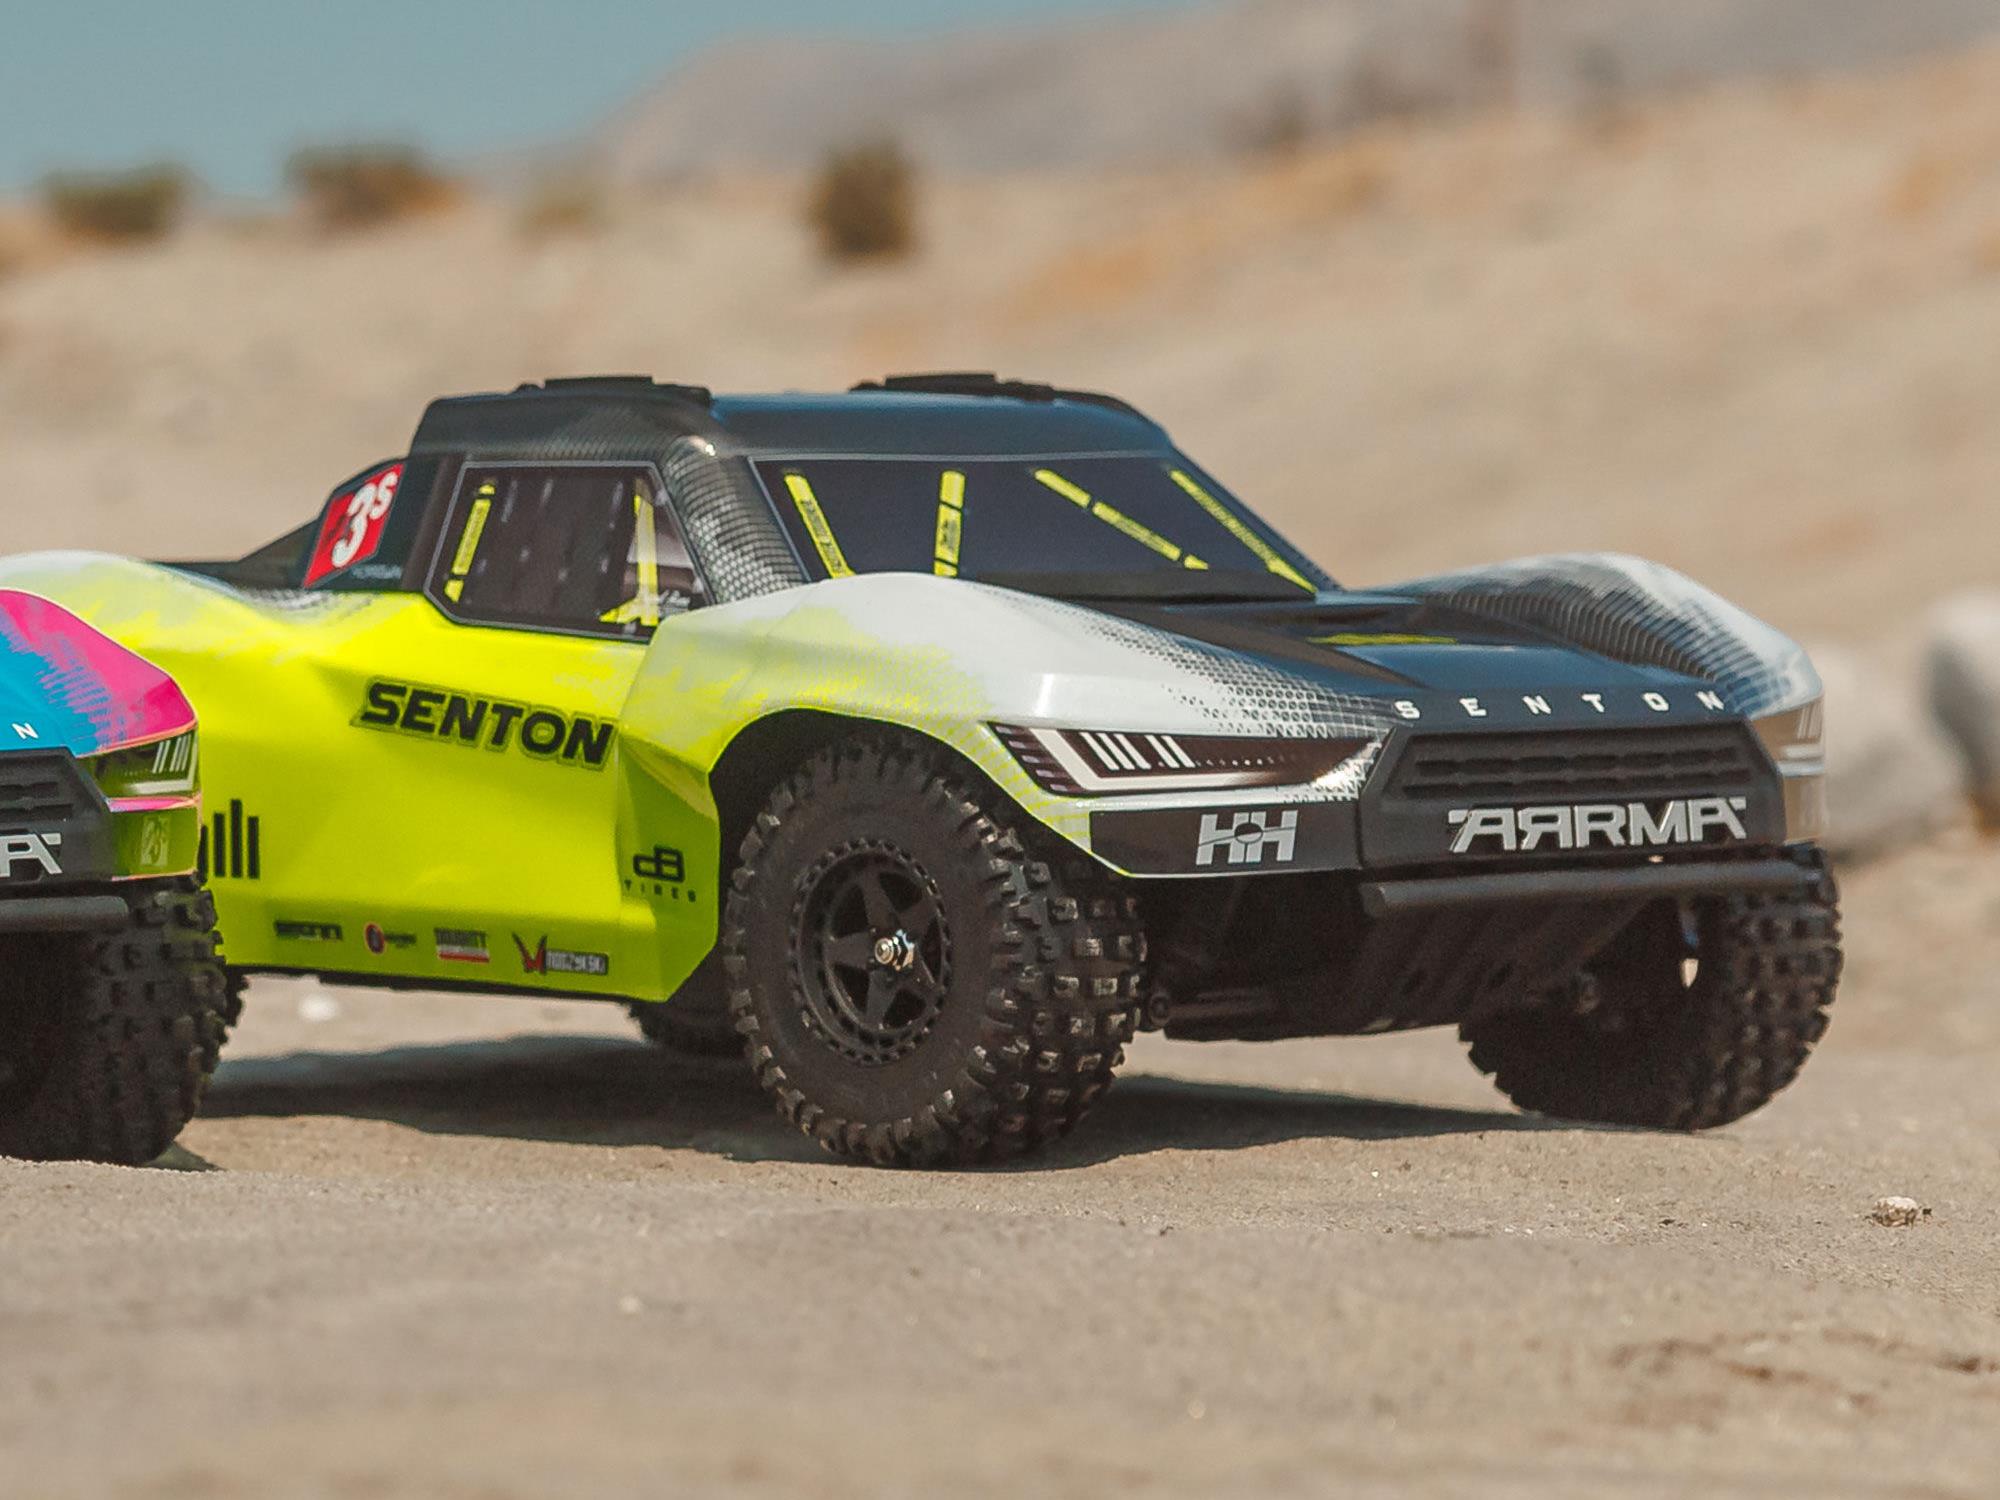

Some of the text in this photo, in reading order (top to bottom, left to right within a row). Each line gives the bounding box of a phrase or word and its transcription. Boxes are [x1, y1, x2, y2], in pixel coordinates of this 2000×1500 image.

[331, 471, 399, 568] 3S
[358, 681, 614, 766] SENTON
[1394, 690, 1725, 720] SENTON
[1448, 797, 1747, 854] ARRMA
